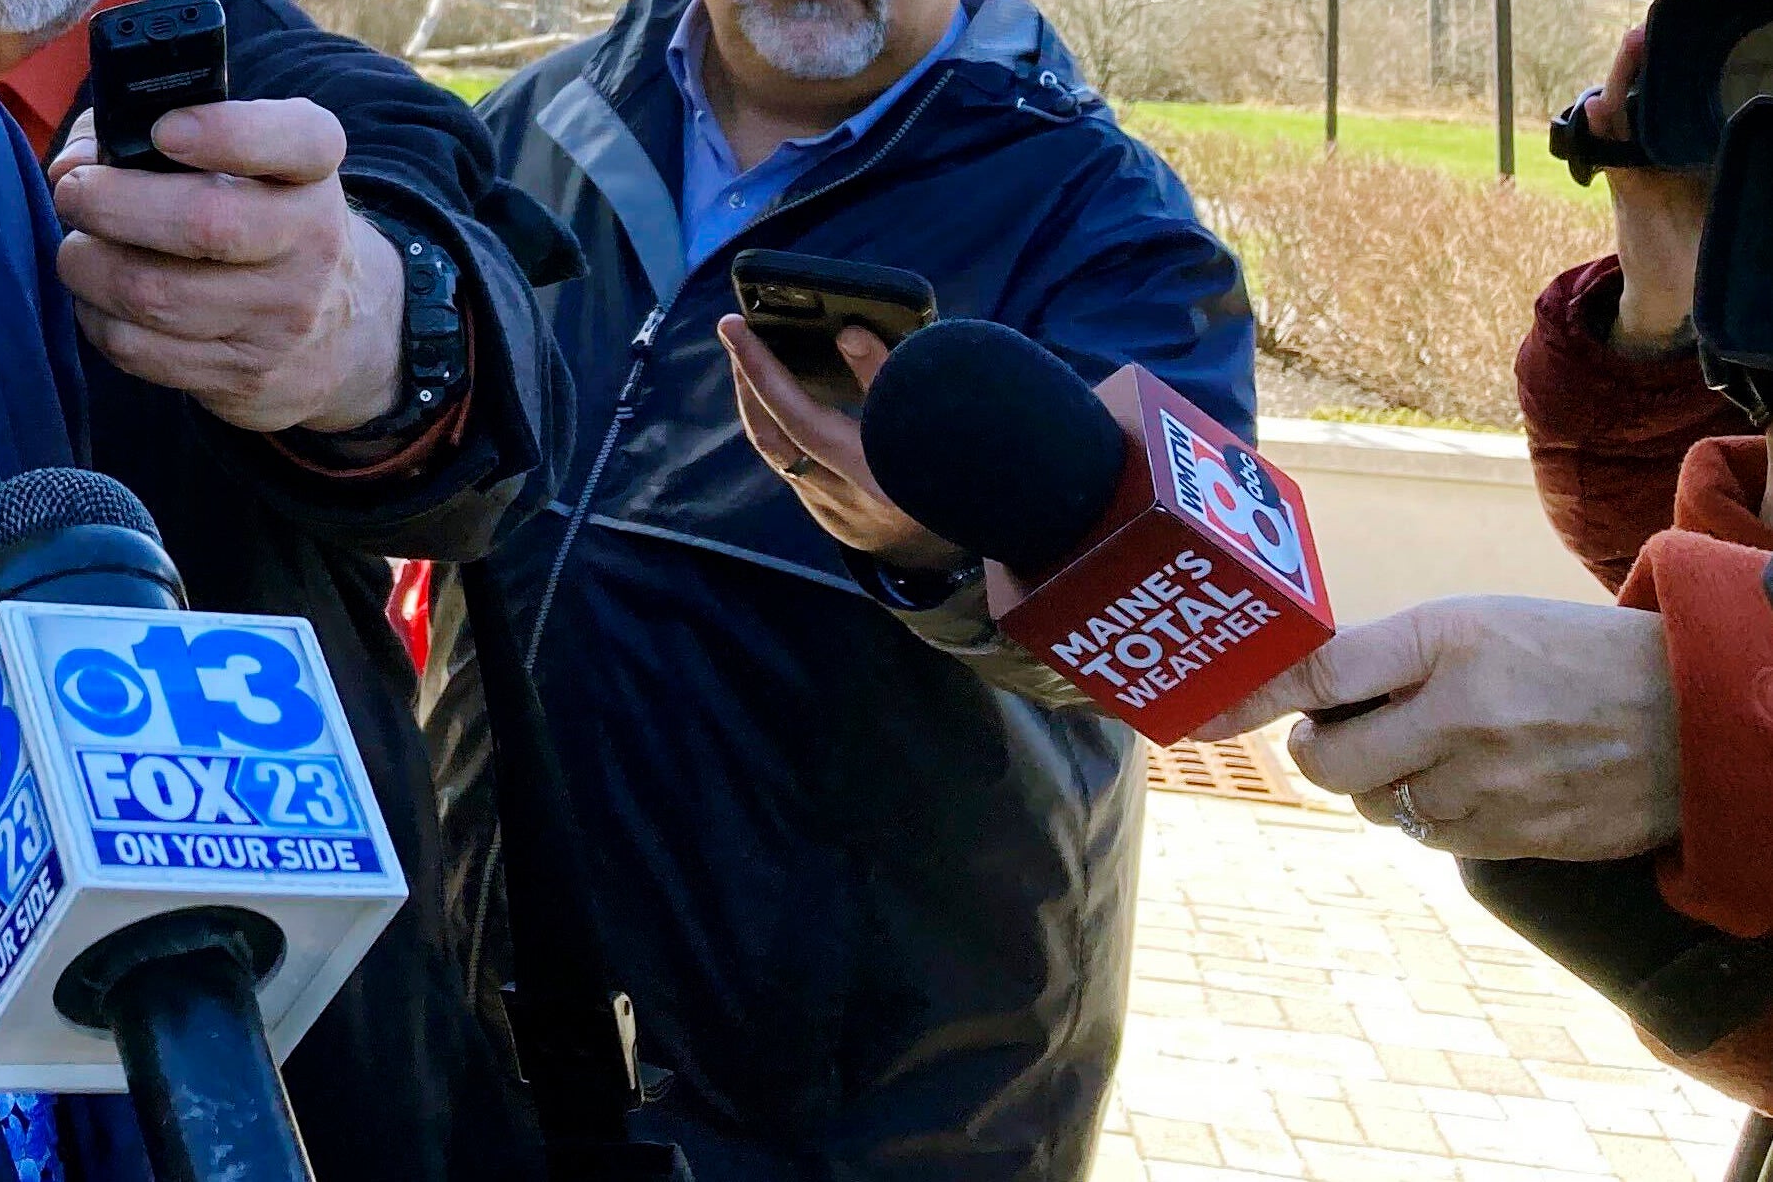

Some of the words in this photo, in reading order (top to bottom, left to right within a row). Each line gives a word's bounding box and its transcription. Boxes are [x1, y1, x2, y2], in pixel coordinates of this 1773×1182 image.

[1166, 418, 1204, 514] WMTW
[1196, 457, 1301, 574] 8
[1243, 452, 1269, 500] abc
[1050, 549, 1213, 668] MAINE'S
[1080, 581, 1253, 688] TOTAL
[1115, 600, 1281, 709] WEATHER
[131, 625, 324, 752] 13
[82, 753, 260, 825] FOX
[254, 763, 349, 827] 23
[114, 832, 170, 866] ON
[172, 834, 274, 869] YOUR
[278, 837, 361, 872] SIDE
[15, 866, 56, 944] SIDE
